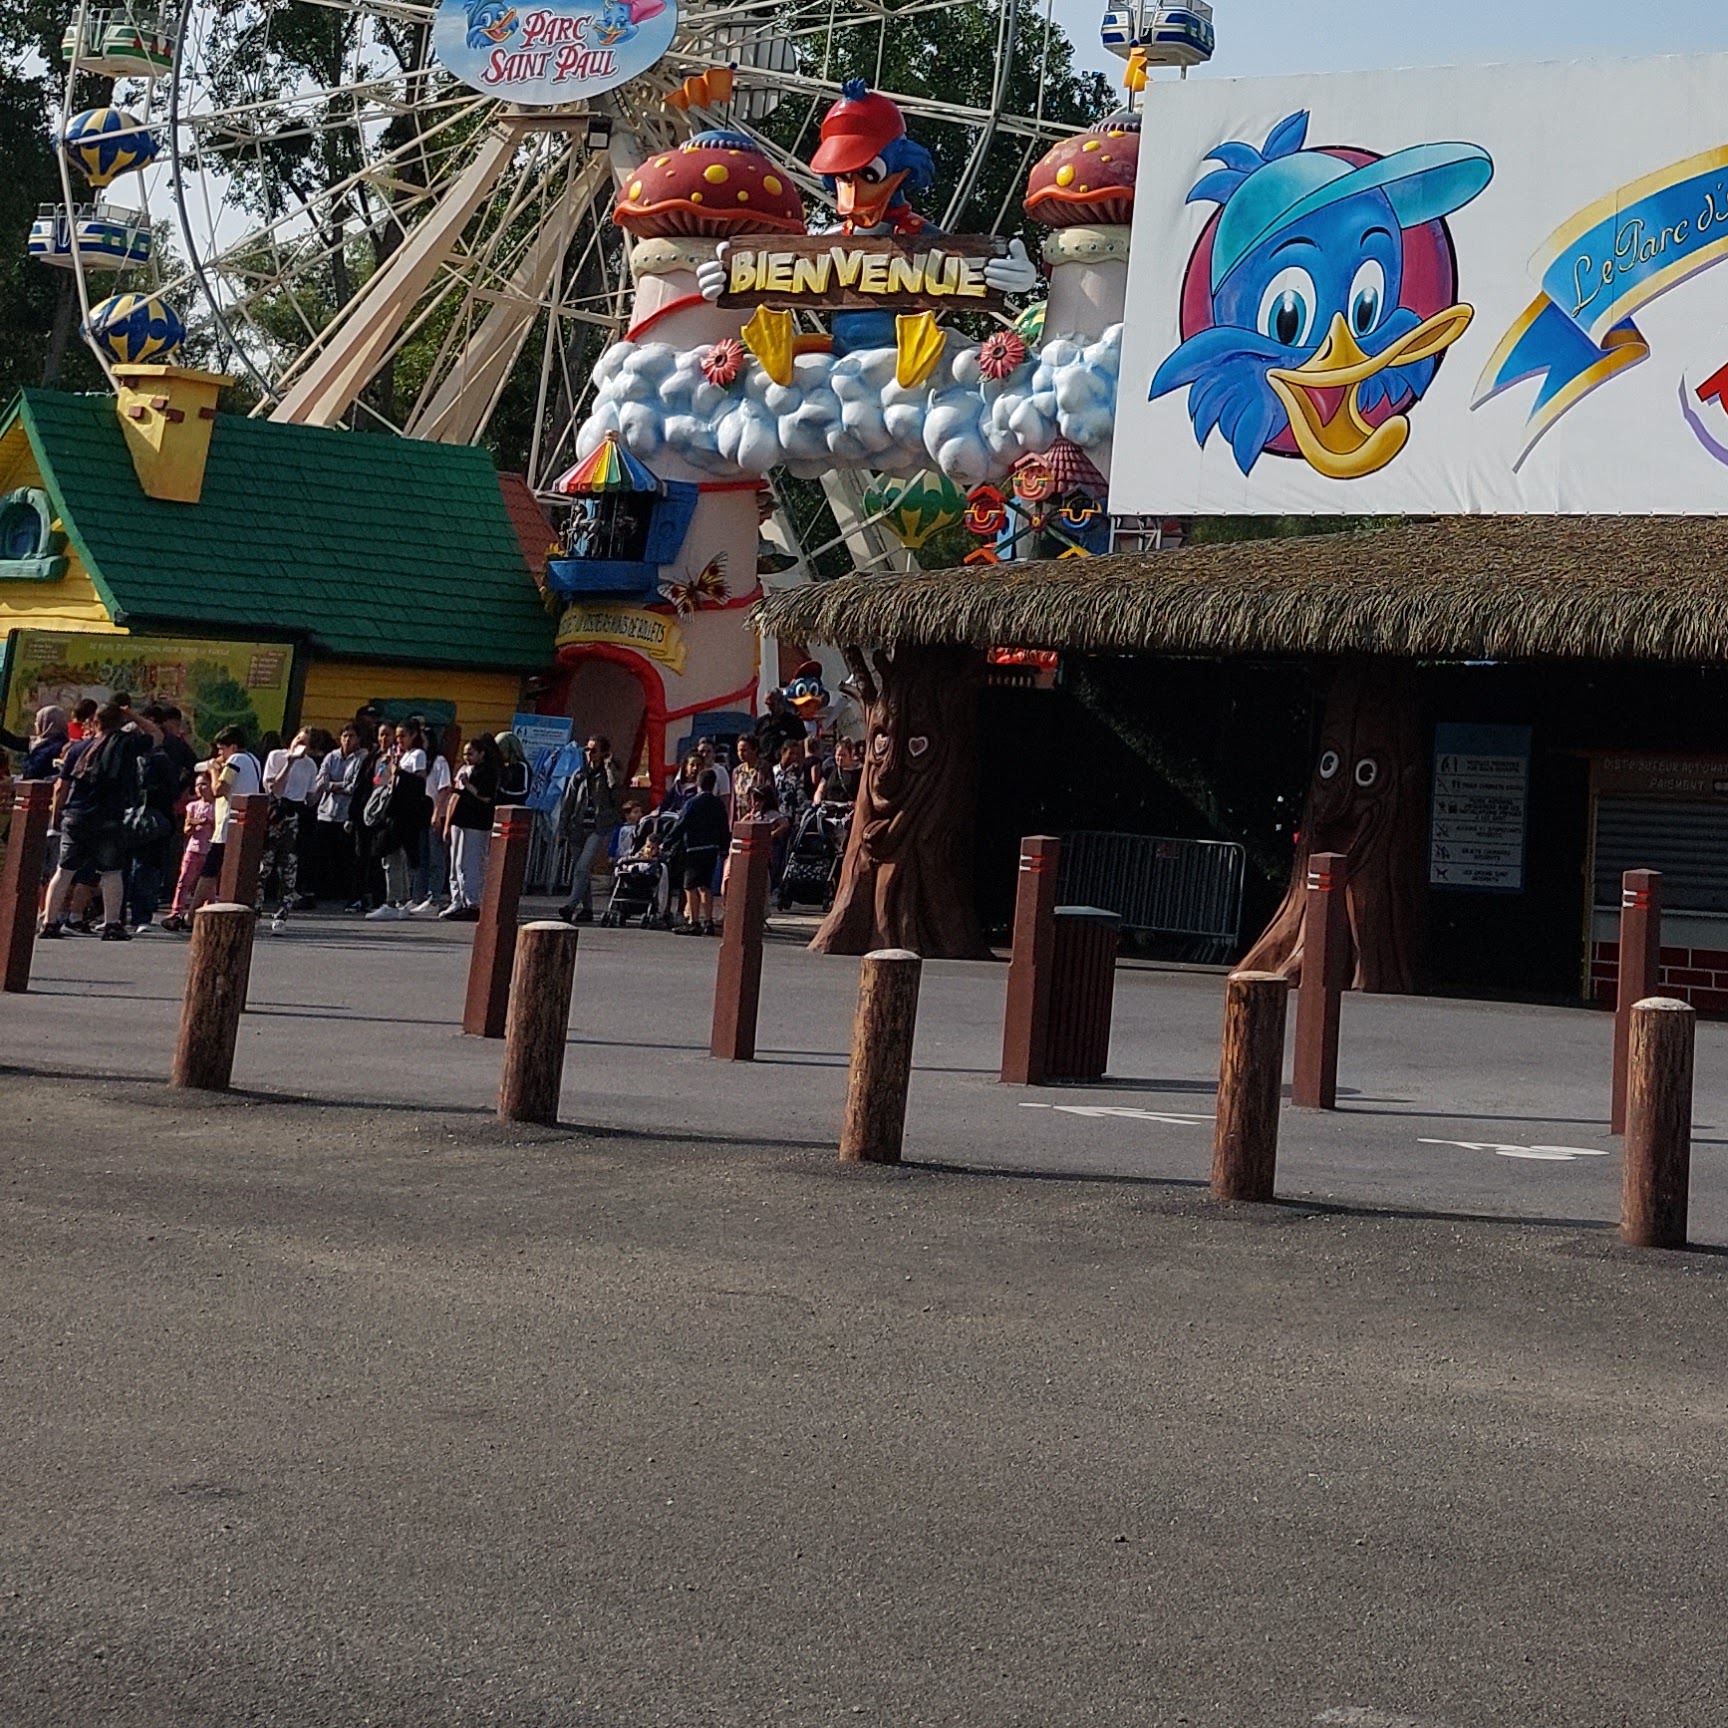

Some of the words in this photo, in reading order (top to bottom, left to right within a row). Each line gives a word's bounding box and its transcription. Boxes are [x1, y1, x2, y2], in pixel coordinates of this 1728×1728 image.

[519, 10, 592, 49] PARC
[481, 49, 552, 83] SAINT
[552, 43, 619, 83] PAUL
[728, 245, 989, 299] BIENVENUE
[1571, 255, 1614, 318] Le
[1614, 218, 1690, 273] Parc
[1603, 758, 1680, 774] DISTRIBUTEUR
[1649, 778, 1705, 791] PAIEMENT
